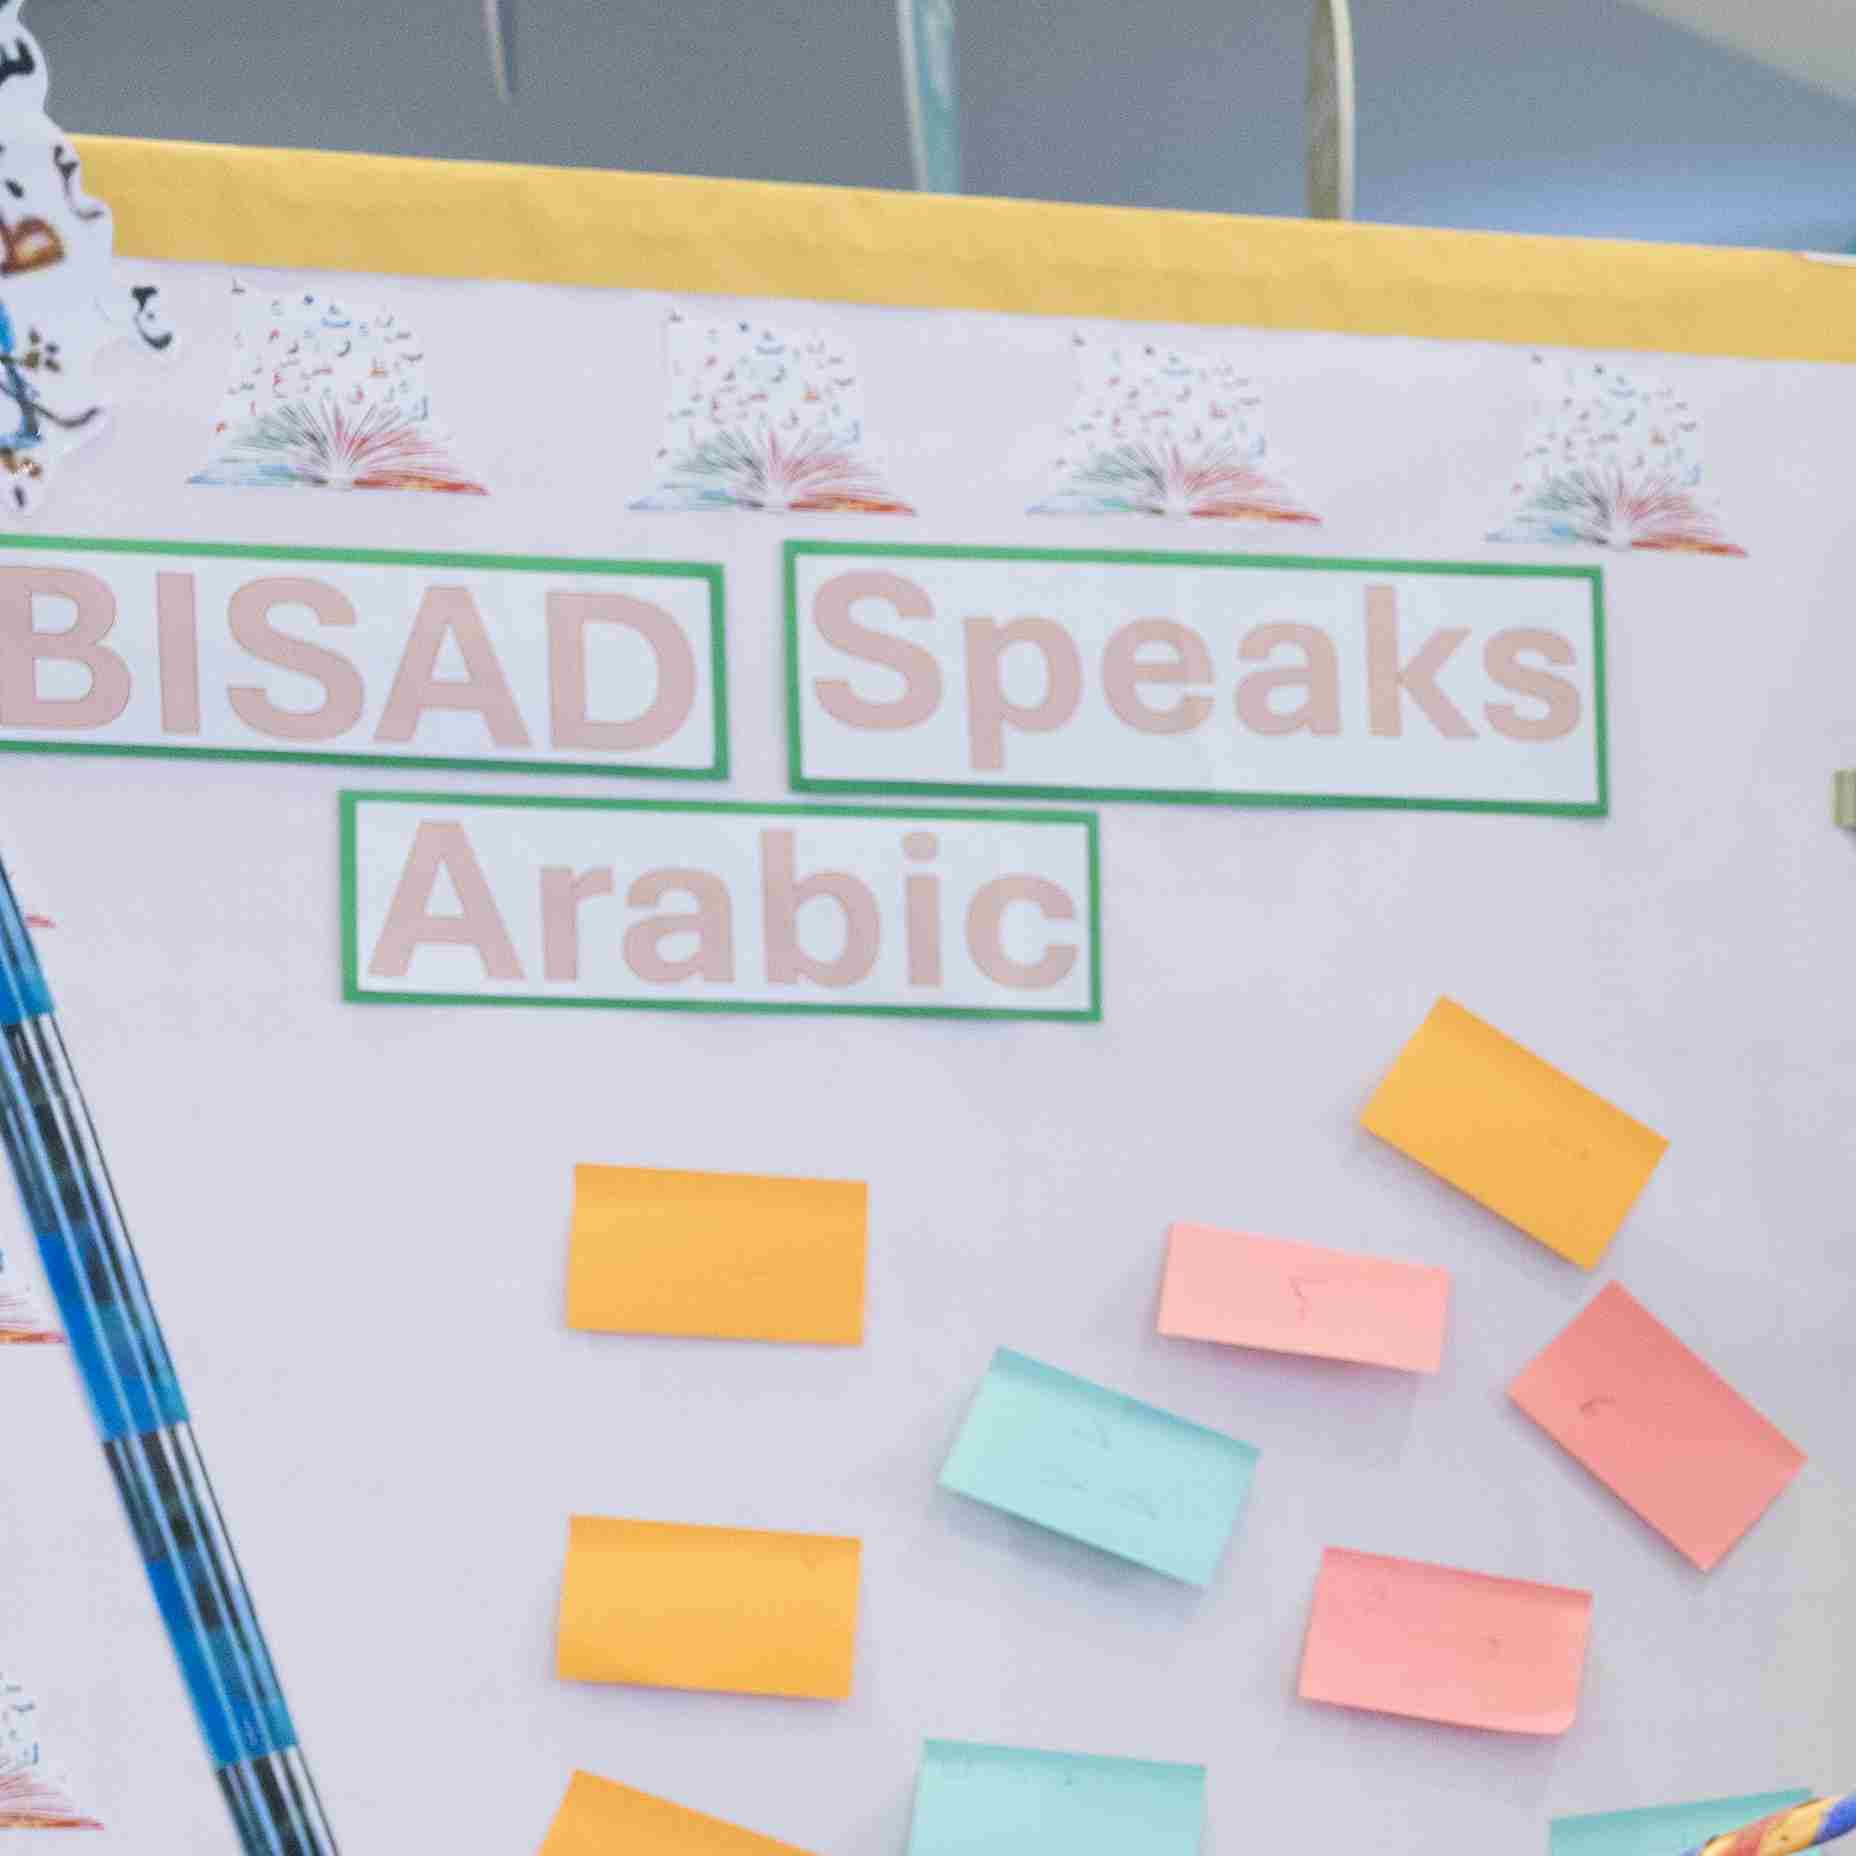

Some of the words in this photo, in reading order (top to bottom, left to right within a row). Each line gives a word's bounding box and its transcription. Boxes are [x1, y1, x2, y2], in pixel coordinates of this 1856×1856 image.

[0, 564, 698, 753] BISAD
[811, 568, 1583, 772] Speaks
[367, 819, 1080, 992] Arabic
